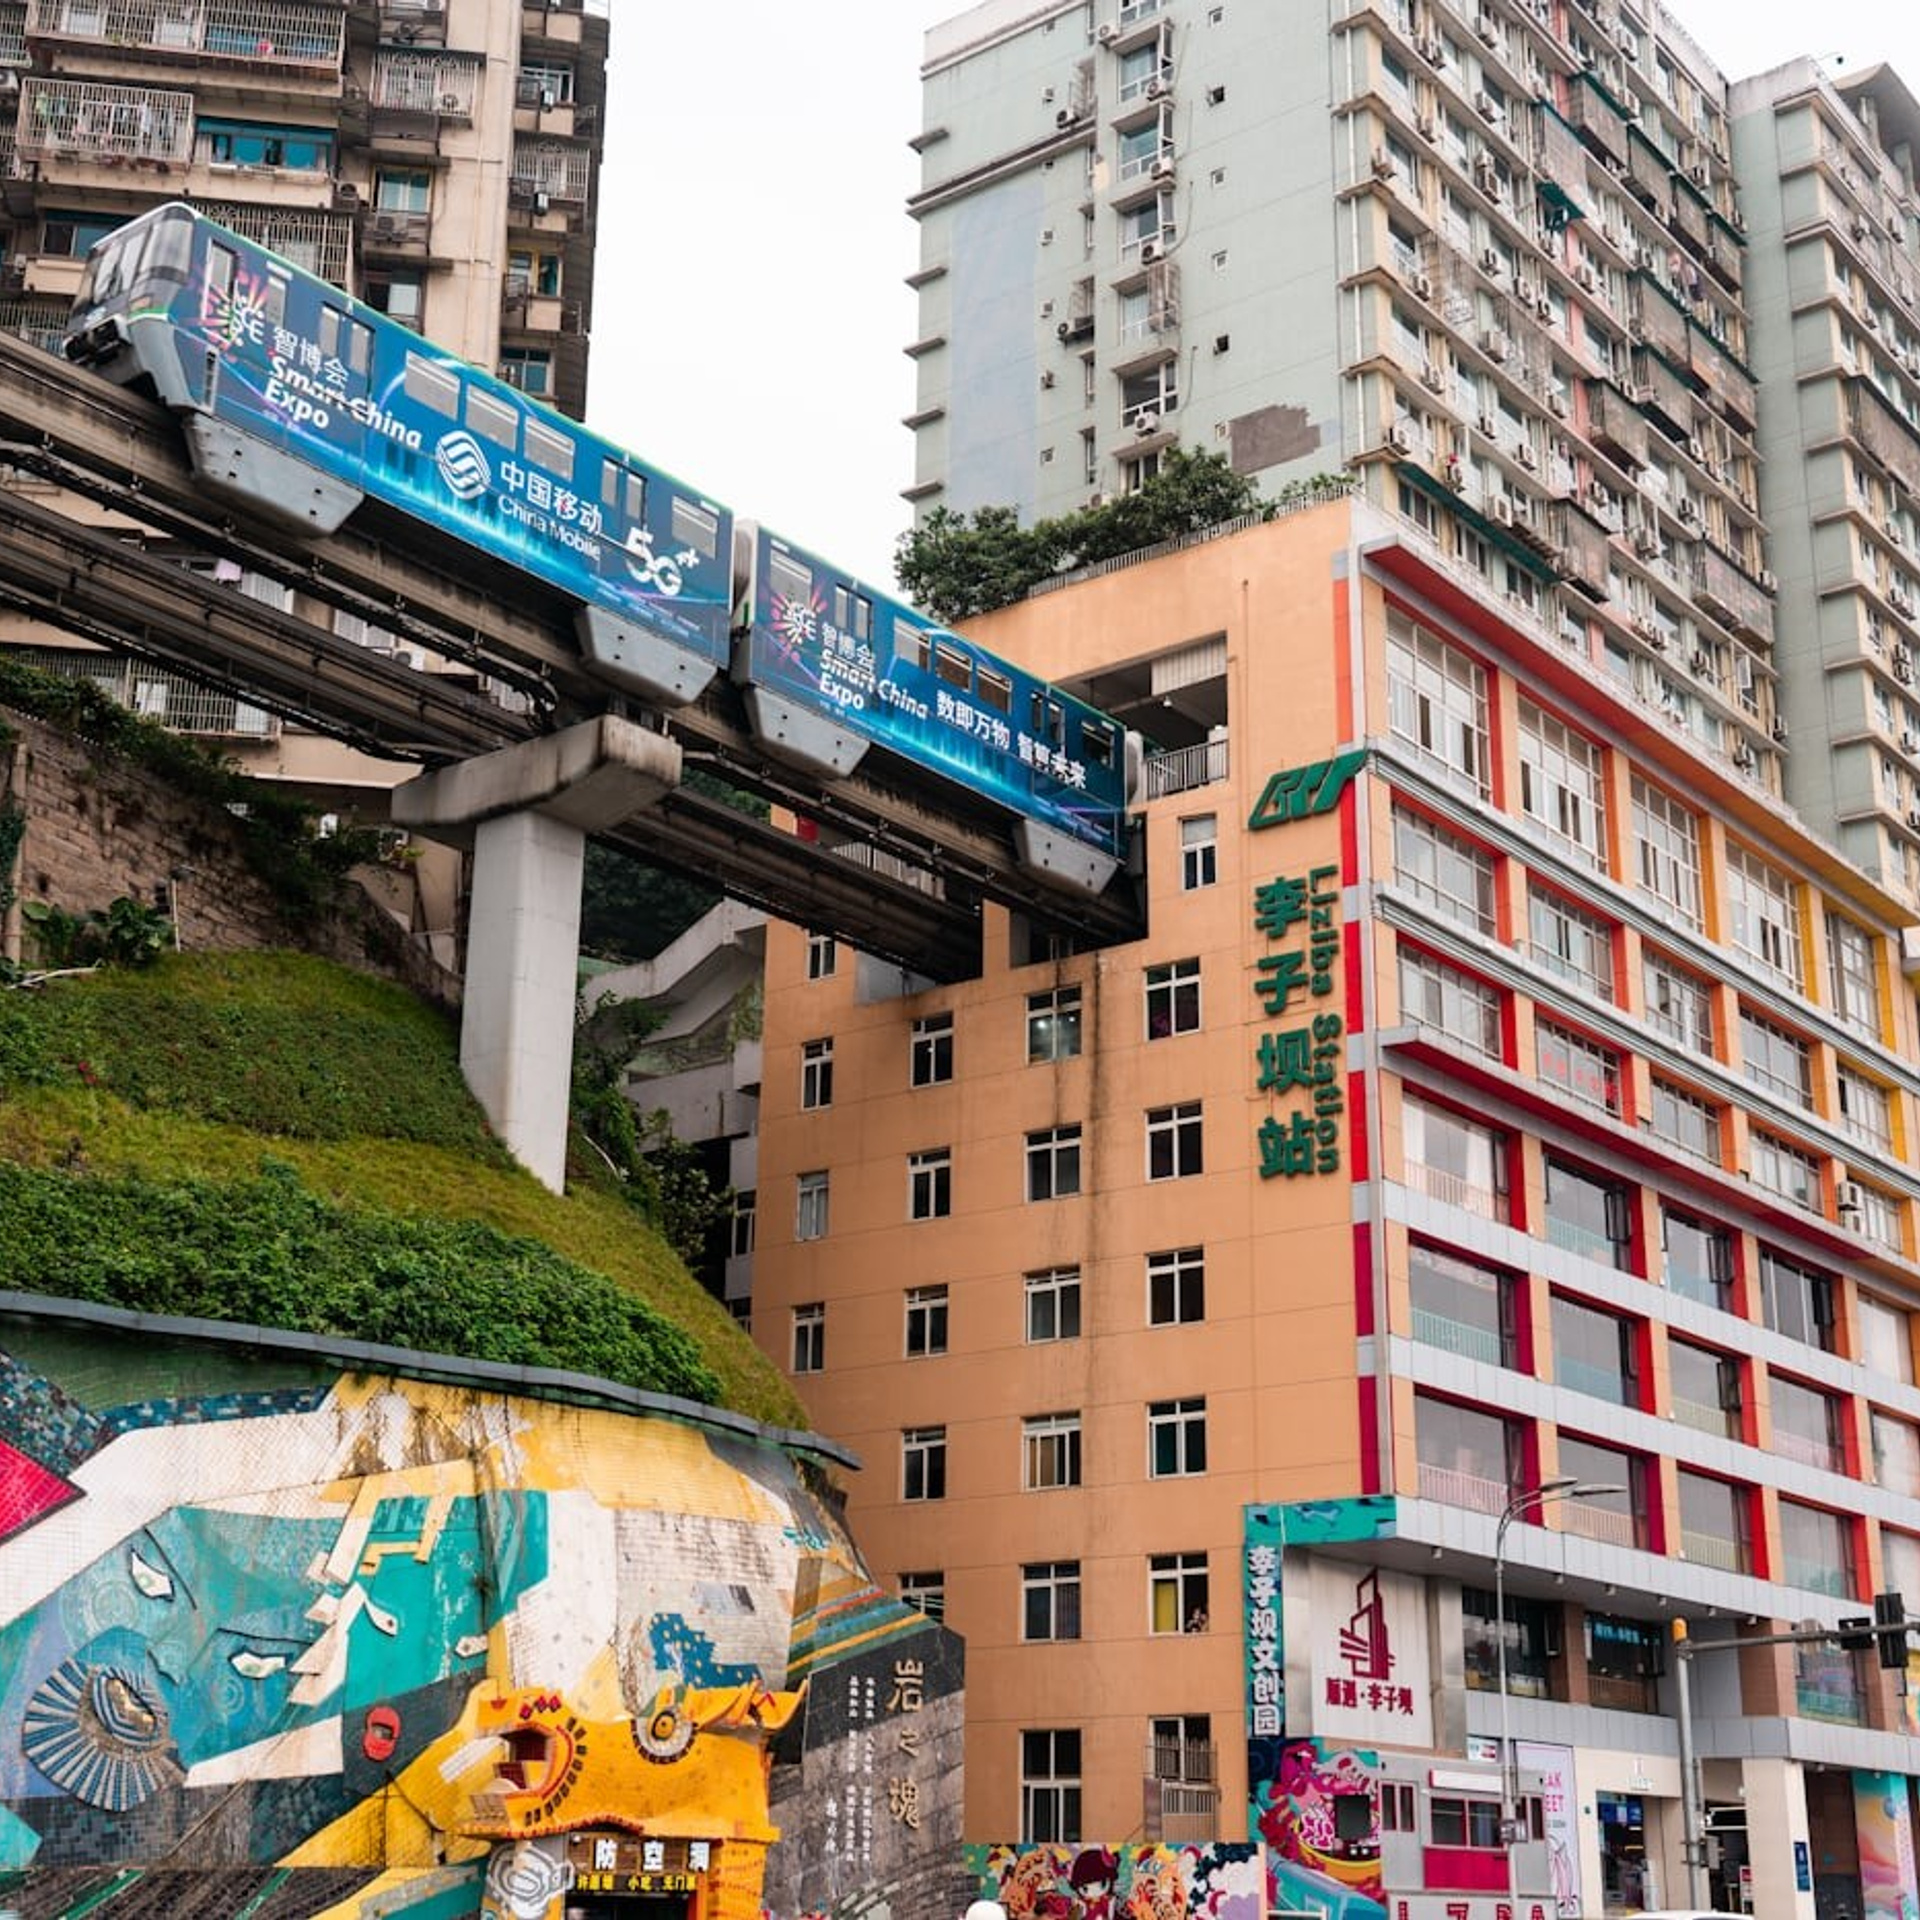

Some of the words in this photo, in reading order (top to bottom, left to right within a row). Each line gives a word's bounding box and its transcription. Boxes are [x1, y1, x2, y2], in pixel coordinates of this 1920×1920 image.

[273, 326, 349, 389] 智博会
[264, 379, 330, 429] Expo
[269, 355, 346, 411] Smart
[350, 397, 422, 449] China
[498, 494, 546, 533] China
[550, 517, 600, 561] Mobile
[500, 460, 602, 534] 中国移动
[821, 622, 876, 673] 智博会
[818, 673, 865, 711] Expo
[819, 649, 876, 692] Smart
[876, 679, 930, 720] China
[1309, 865, 1339, 997] Liziba
[1253, 874, 1317, 1180] 李子坝站
[1311, 1012, 1344, 1174] Station
[1247, 1544, 1281, 1737] 李子坝文创园
[595, 1838, 711, 1872] 防空洞
